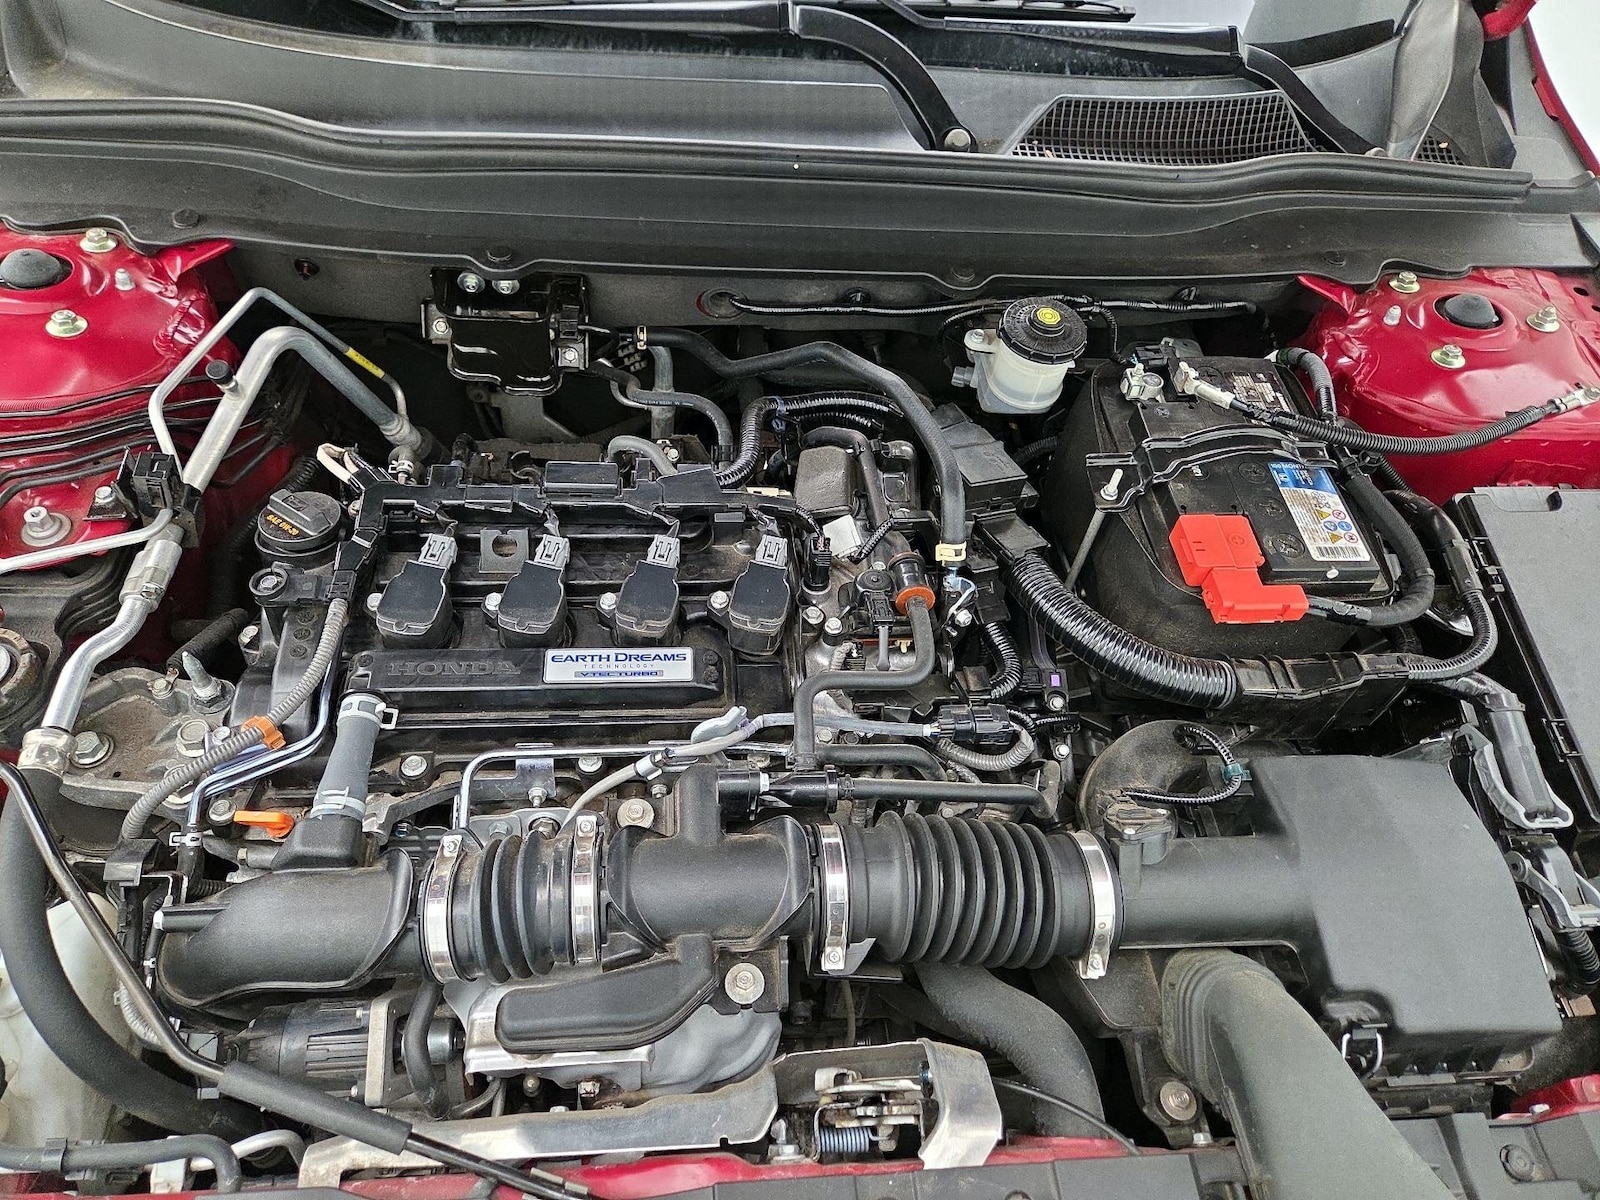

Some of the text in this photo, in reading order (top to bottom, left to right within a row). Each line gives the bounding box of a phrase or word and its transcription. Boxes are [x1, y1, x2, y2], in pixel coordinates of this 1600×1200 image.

[551, 653, 687, 663] EARTH DREAMS
[387, 660, 521, 676] HONDA
